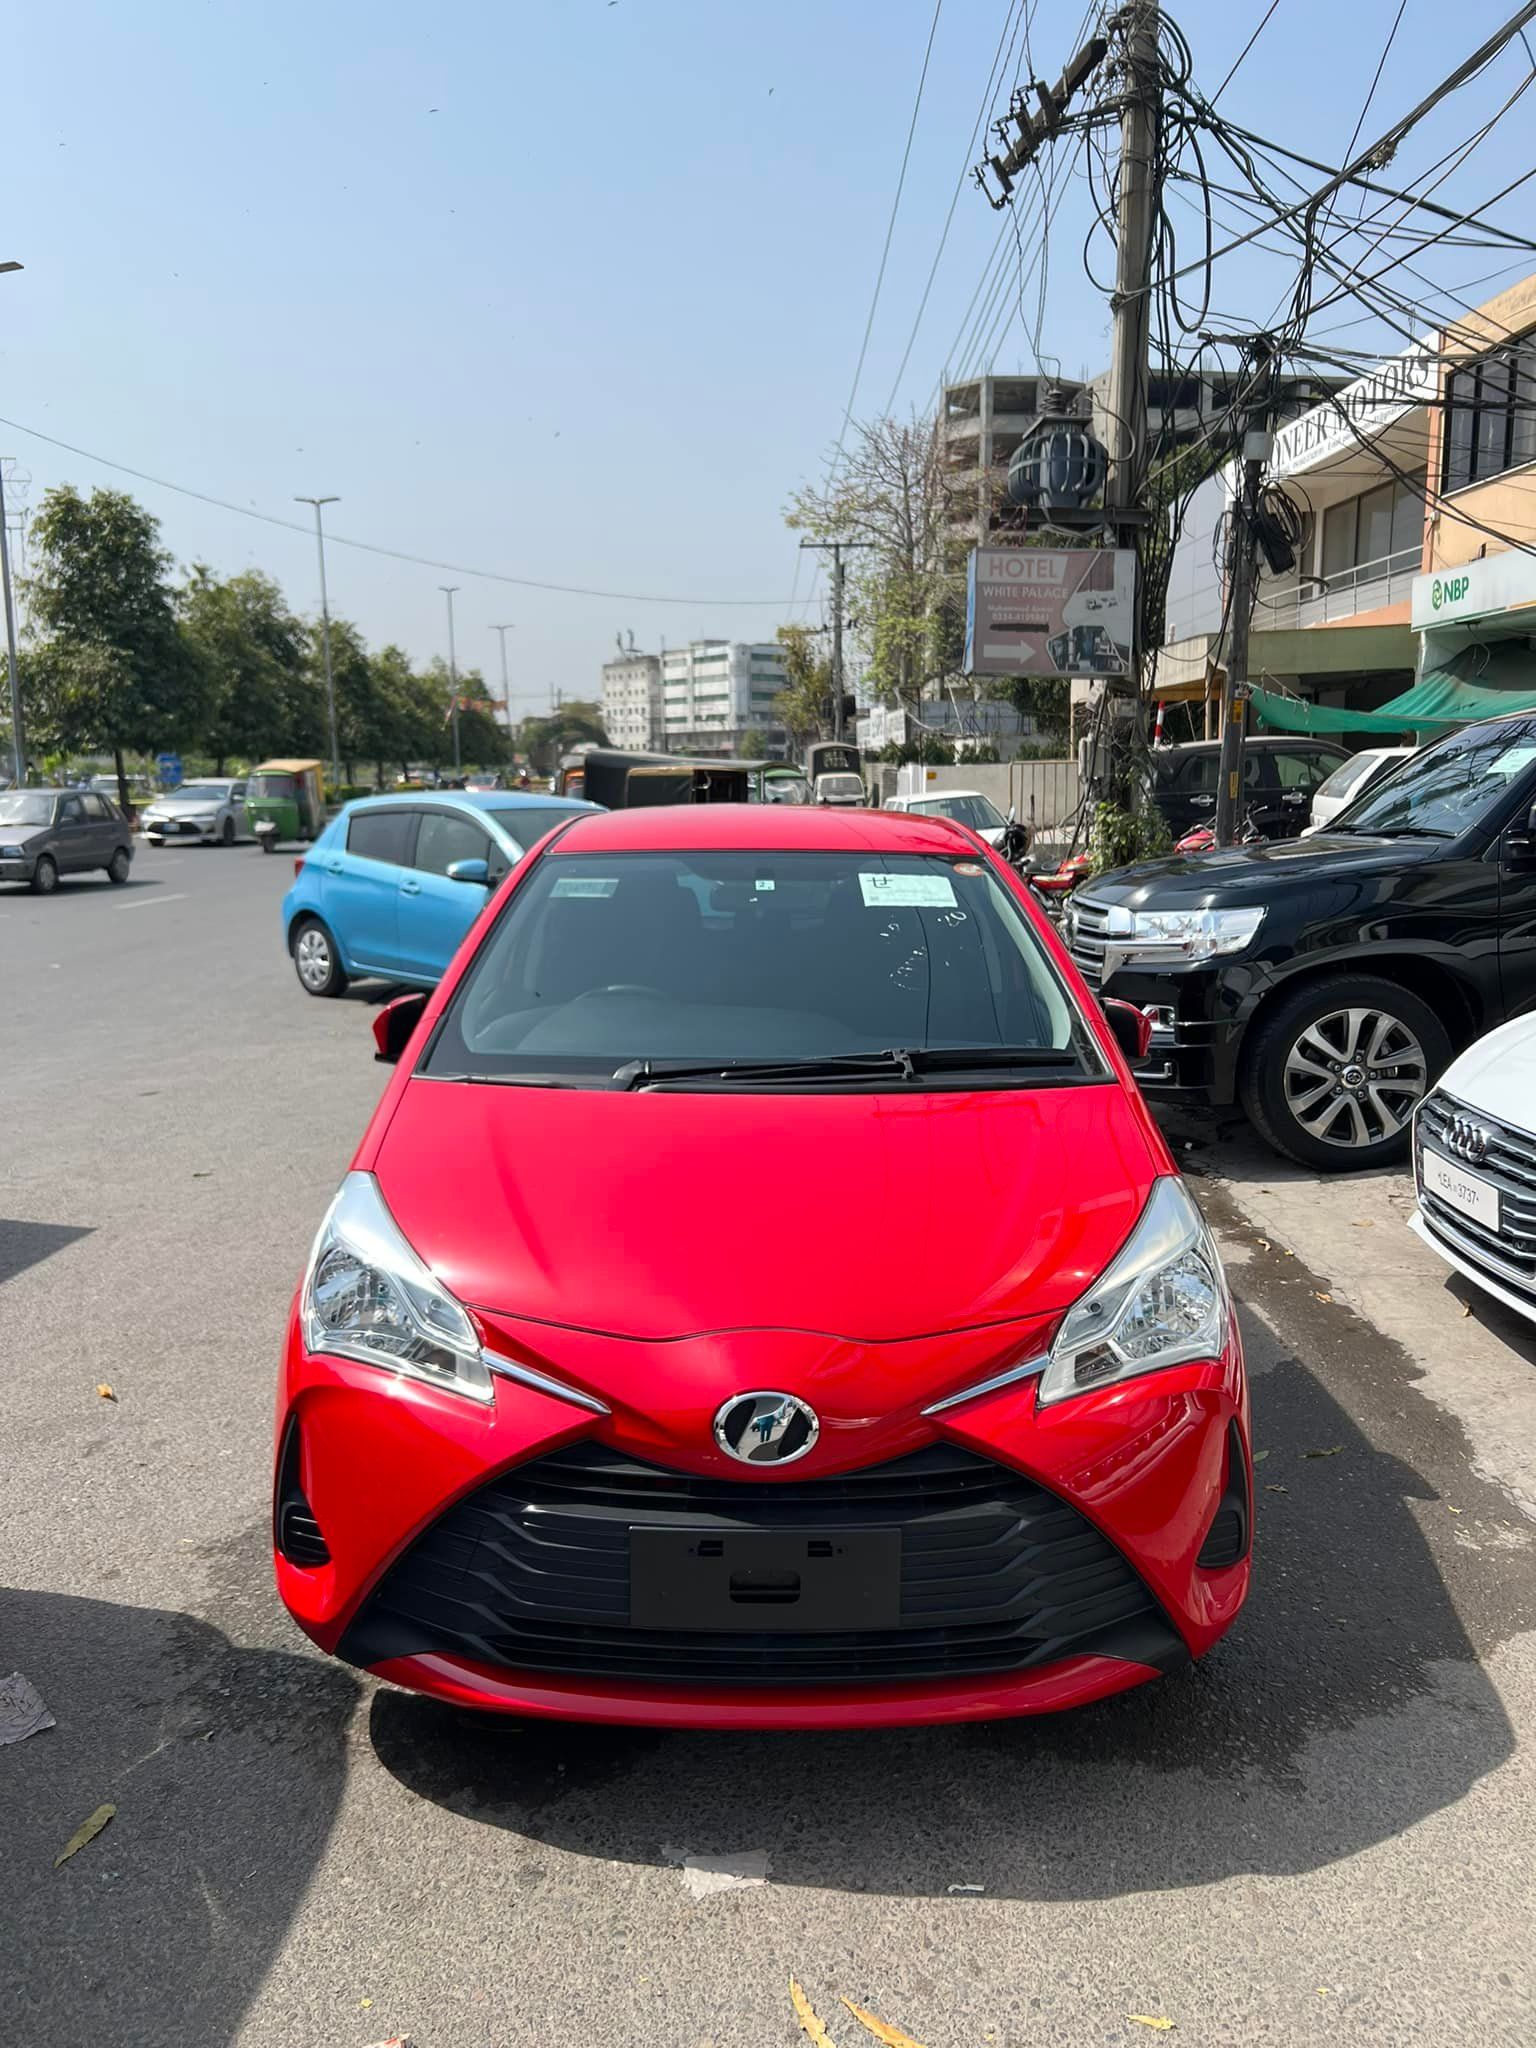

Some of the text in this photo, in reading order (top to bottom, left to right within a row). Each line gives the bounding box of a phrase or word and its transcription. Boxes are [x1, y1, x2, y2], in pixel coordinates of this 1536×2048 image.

[990, 557, 1057, 578] HOTEL
[983, 585, 1069, 599] WHITE PALACE
[1444, 576, 1469, 603] NBP
